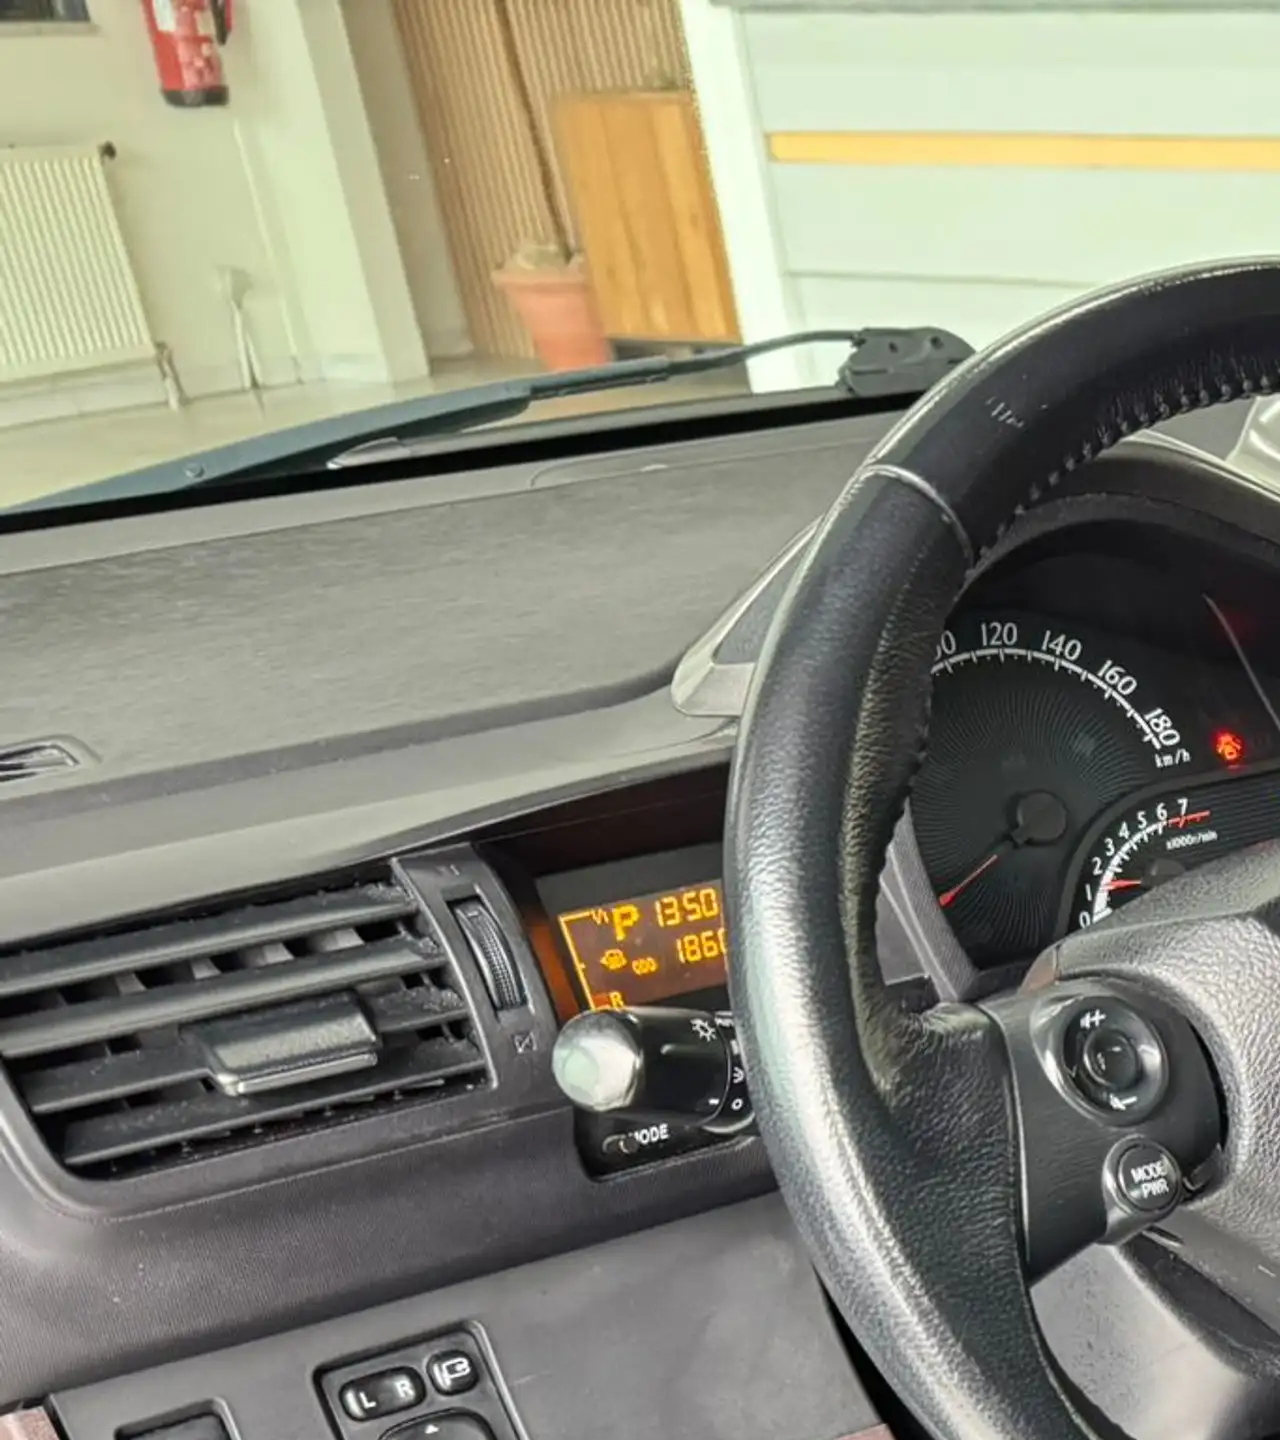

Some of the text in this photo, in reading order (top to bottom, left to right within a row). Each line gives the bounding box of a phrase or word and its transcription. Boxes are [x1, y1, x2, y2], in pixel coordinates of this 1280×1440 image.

[981, 622, 1018, 646] 120
[1041, 630, 1082, 661] 140
[1097, 659, 1138, 696] 160
[1144, 707, 1181, 747] 180
[1154, 748, 1191, 768] km/h
[1079, 797, 1188, 929] 0 1 2 3 4 5 6 7
[612, 904, 640, 941] P
[608, 991, 624, 1009] R
[1131, 1160, 1168, 1184] MODE
[1141, 1179, 1169, 1199] PWR
[360, 1378, 415, 1409] L R
